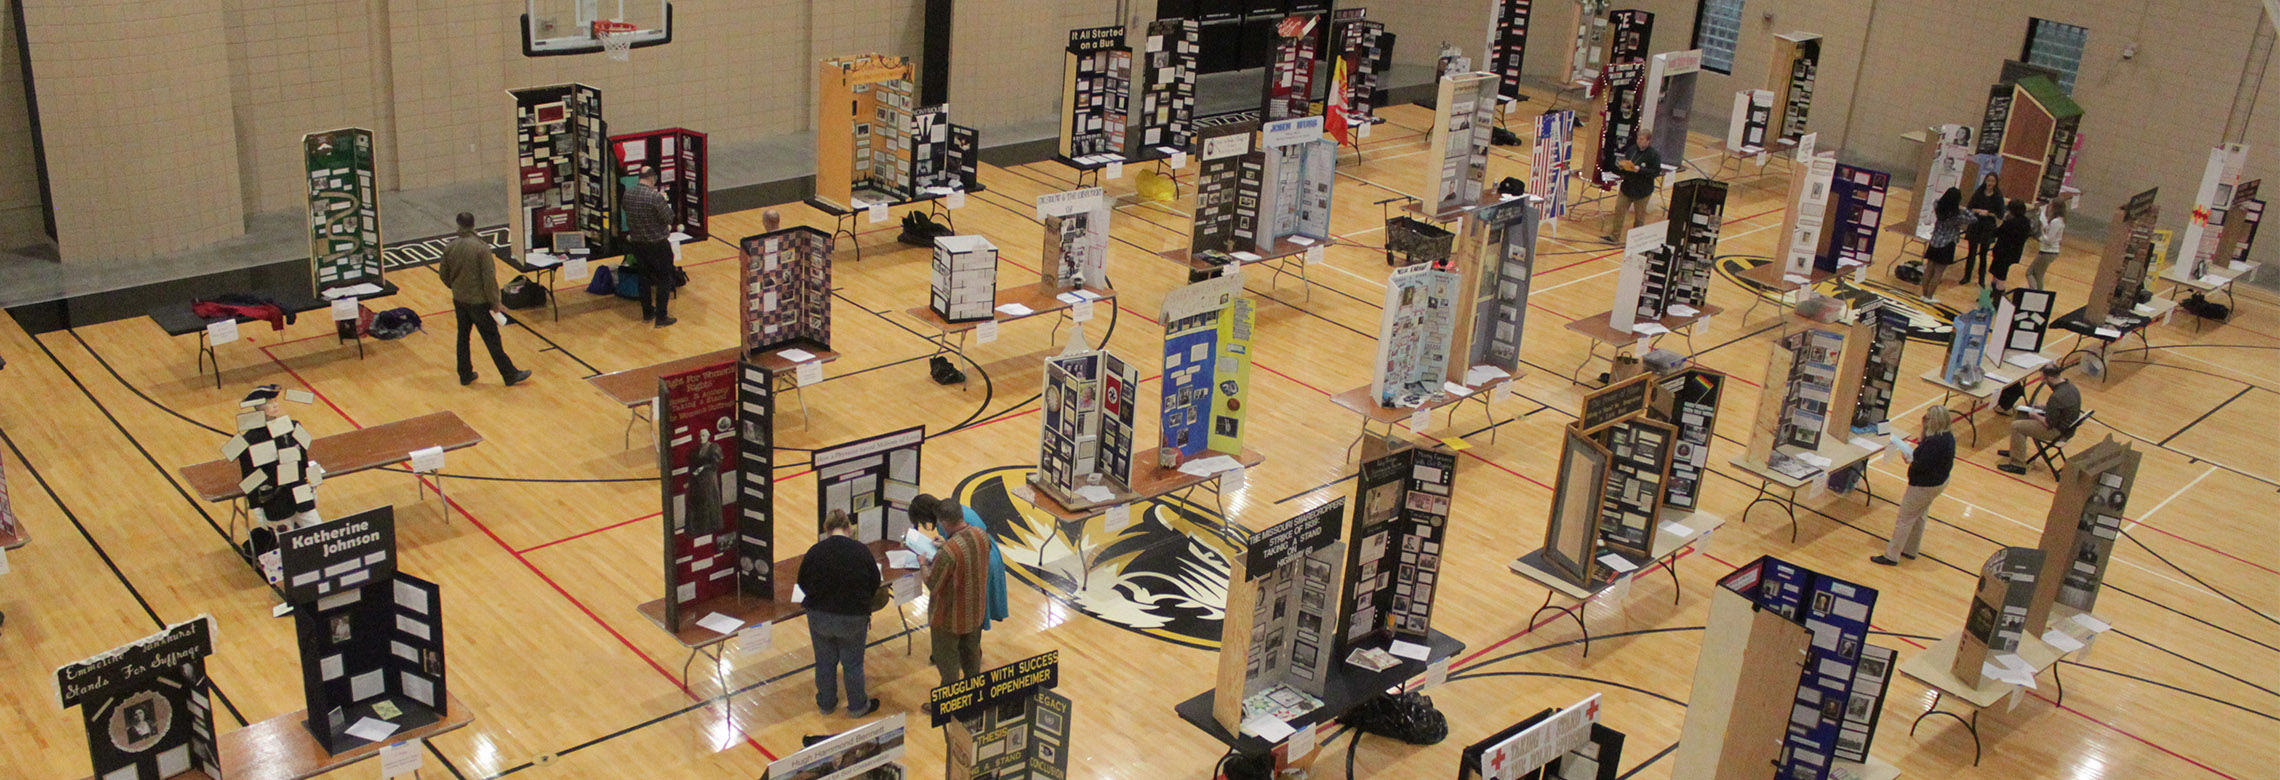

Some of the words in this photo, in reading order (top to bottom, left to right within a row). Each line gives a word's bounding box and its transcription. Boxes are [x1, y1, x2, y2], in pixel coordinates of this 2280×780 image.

[1072, 32, 1078, 40] It
[1080, 30, 1090, 40] All
[1092, 27, 1123, 39] Started
[1099, 39, 1114, 48] Bus
[292, 521, 368, 550] Katherine
[1261, 520, 1293, 540] MISSOURI
[1269, 530, 1293, 547] STRIKE
[1294, 524, 1304, 535] OF
[323, 531, 380, 557] Johnson
[1263, 541, 1288, 559] TAKING
[1292, 537, 1297, 546] A
[1299, 526, 1322, 543] STAND
[1287, 545, 1297, 555] ON
[65, 675, 109, 700] Stands
[121, 664, 146, 680] For
[151, 645, 199, 668] Suffrage
[931, 675, 986, 702] STRUGGLING
[990, 665, 1014, 683] WITH
[1018, 651, 1059, 674] SUCCESS
[939, 693, 973, 715] ROBERT
[990, 668, 1051, 698] OPPENHEIMER
[1033, 693, 1067, 713] LEGACY
[791, 755, 813, 768] Hugh
[814, 738, 854, 759] Hammond
[855, 726, 885, 743] Bennett
[976, 727, 1009, 746] THESIS
[995, 752, 1022, 767] STAND
[1029, 757, 1065, 780] CONCLUSION
